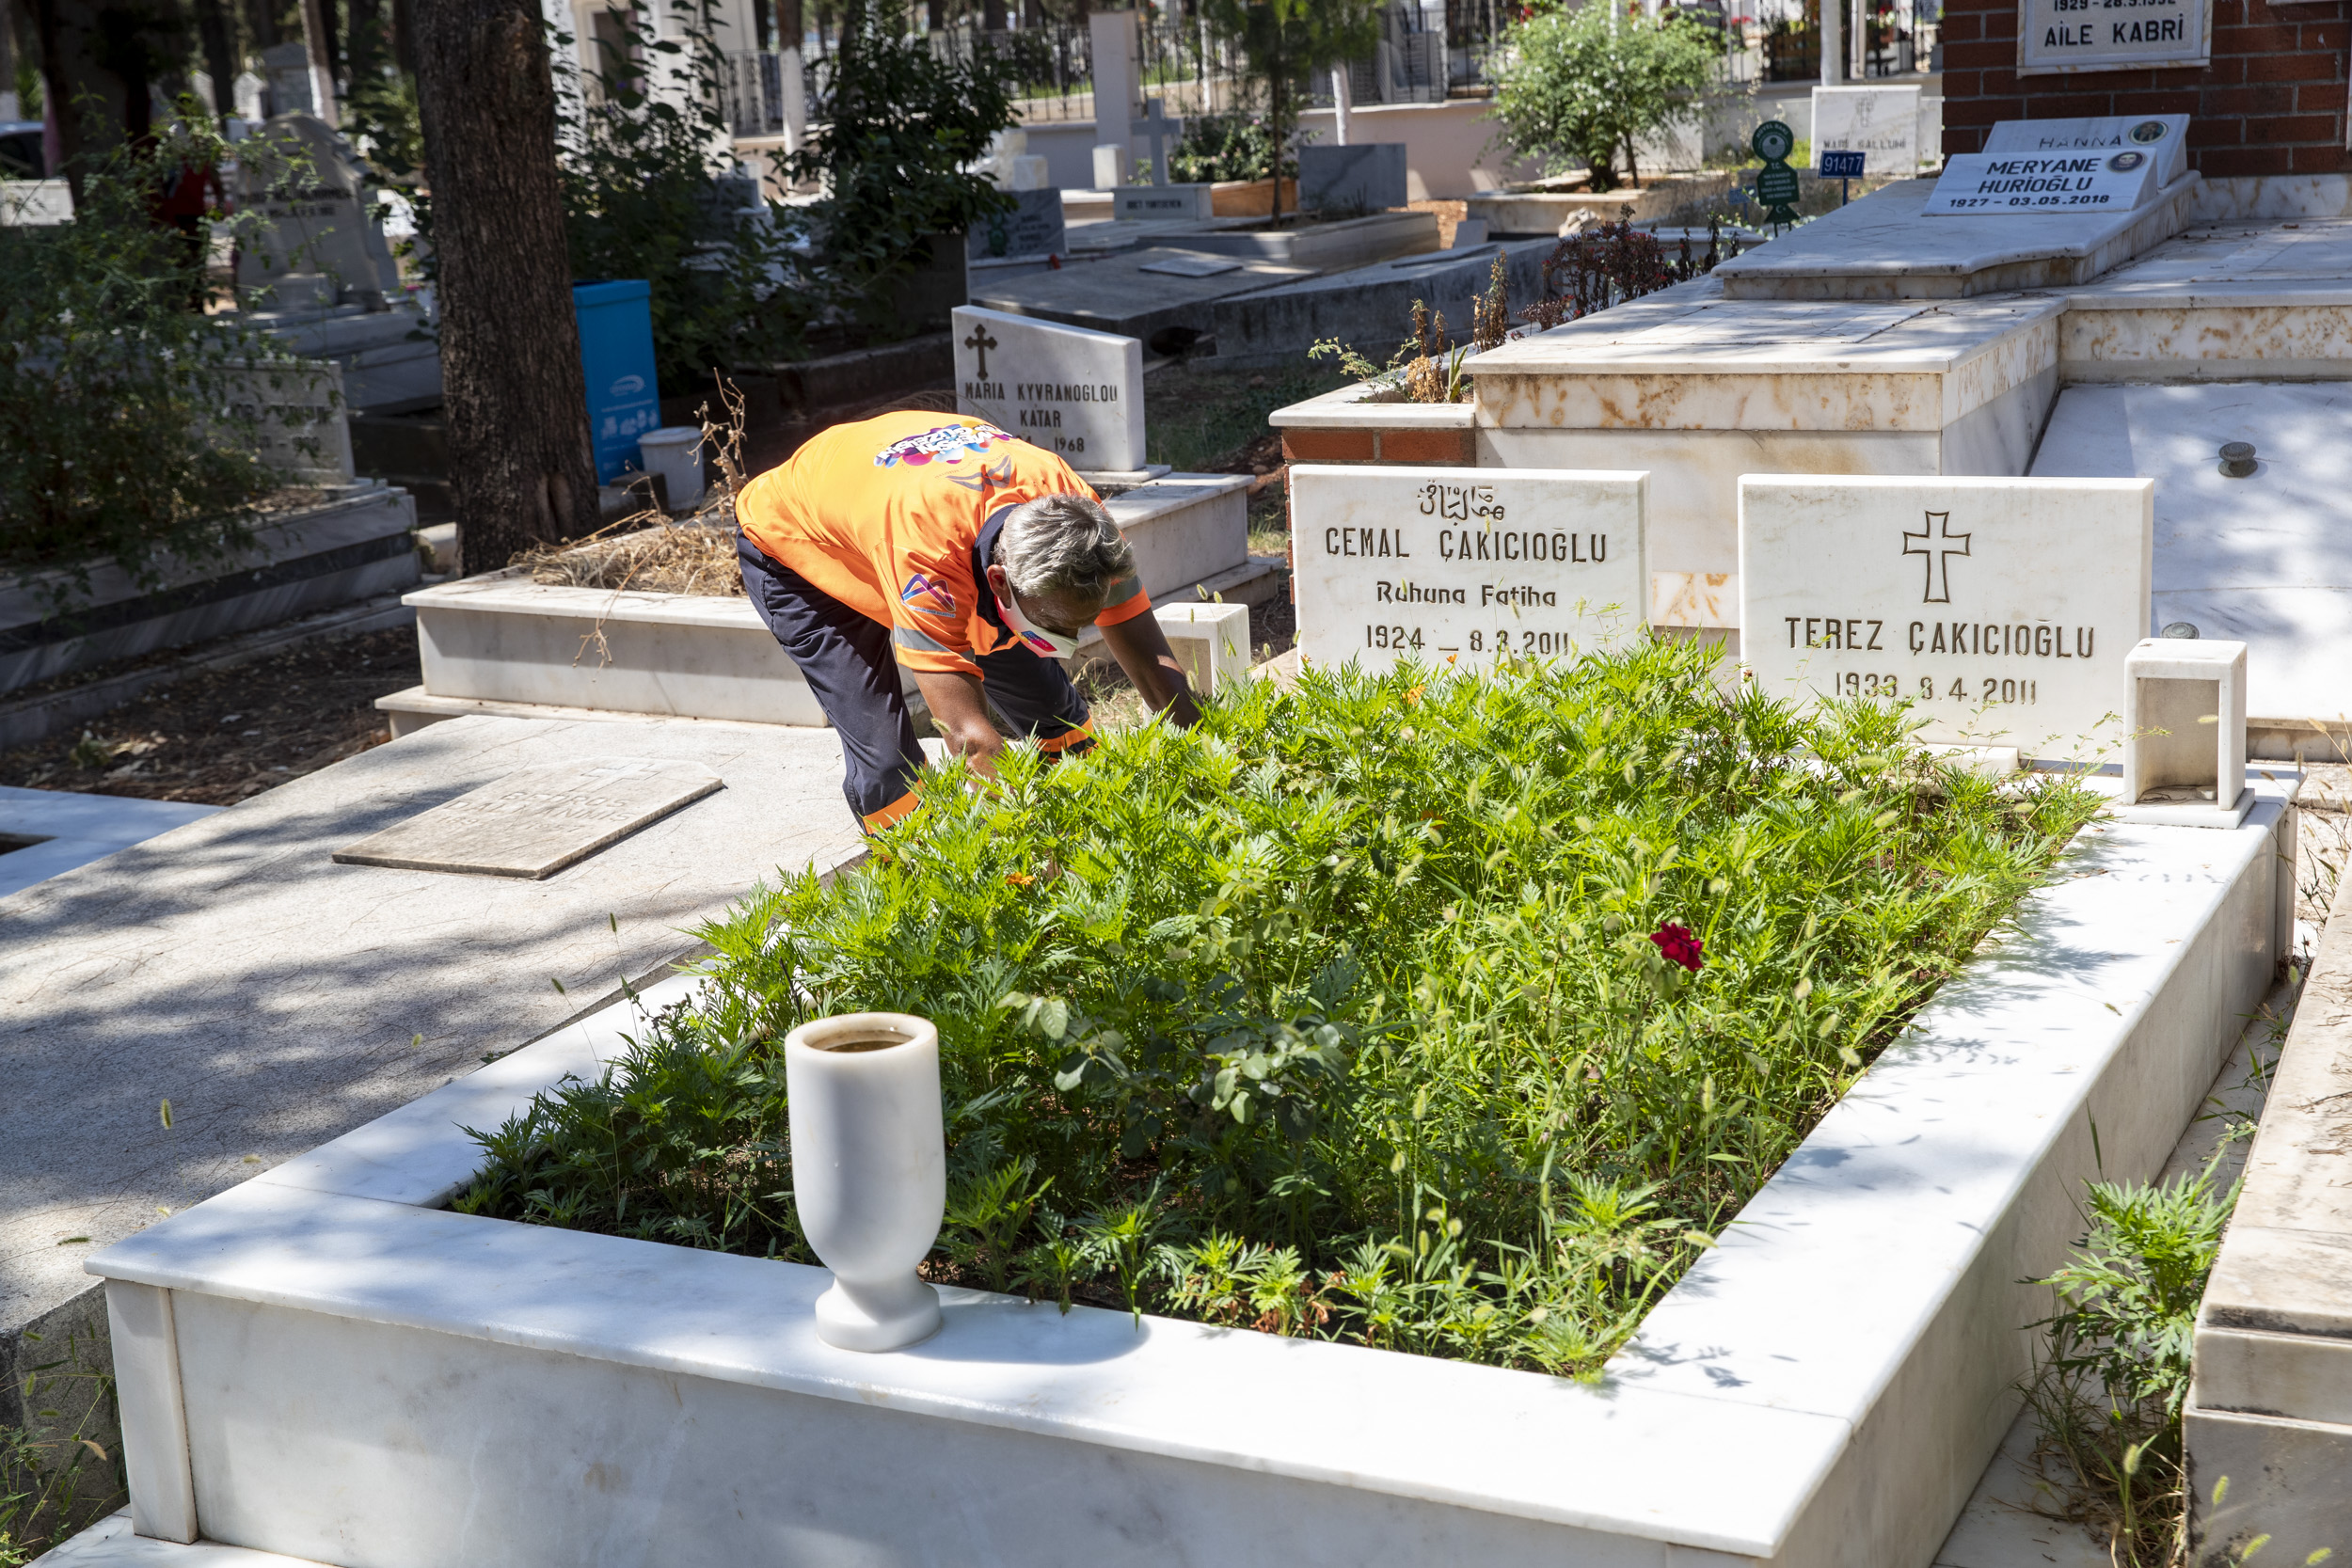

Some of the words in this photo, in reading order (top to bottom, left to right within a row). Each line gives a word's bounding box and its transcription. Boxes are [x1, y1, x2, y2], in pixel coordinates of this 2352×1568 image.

[2044, 21, 2093, 47] AİLE
[2112, 13, 2184, 43] KABRİ
[2038, 135, 2122, 150] HANNA
[1824, 156, 1863, 172] 91477
[1986, 157, 2102, 176] MERYANE
[1978, 175, 2093, 194] HURİOĞLU
[1949, 198, 1990, 208] 1927
[2008, 195, 2110, 206] 03.05.2018
[965, 382, 1005, 401] MARIA
[1017, 383, 1118, 403] KYVRANOGLOU
[1020, 409, 1061, 428] KATAR
[1054, 436, 1085, 452] 1968
[1326, 527, 1410, 558] CEMAL
[1439, 527, 1607, 563] ÇAKICIOĞLU
[1376, 580, 1466, 605] Ruhuna
[1481, 584, 1556, 608] Fatiha
[1367, 625, 1425, 651] 1924
[1470, 629, 1568, 657] 8.3.2011
[1785, 617, 1883, 651] TEREZ
[1909, 619, 2094, 658] ÇAKICIOĞLU
